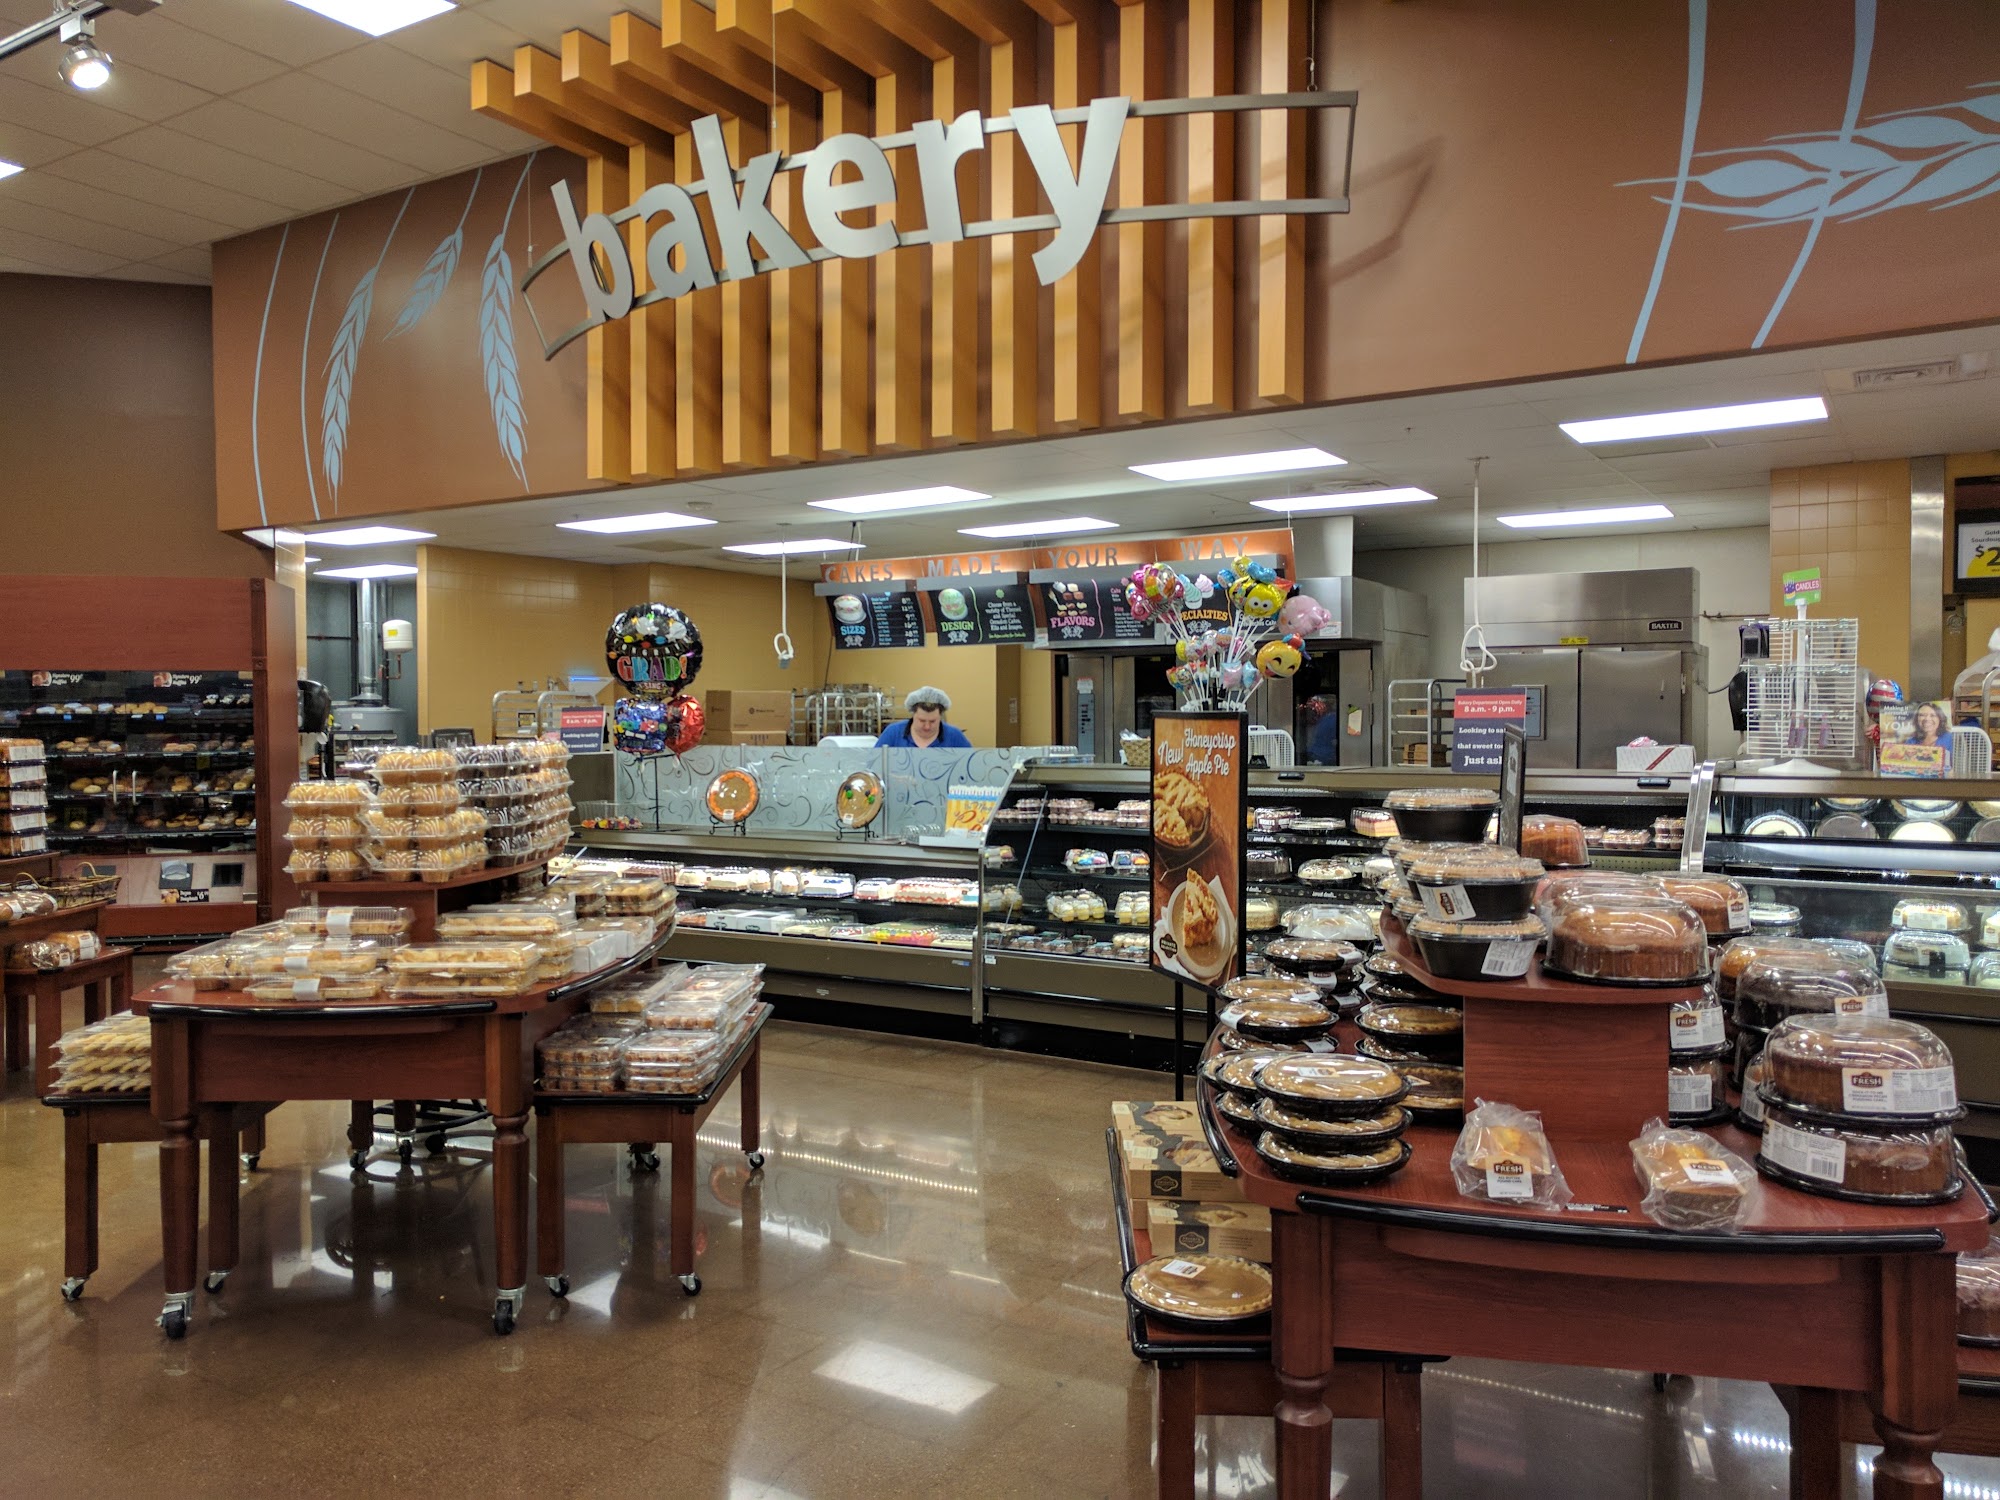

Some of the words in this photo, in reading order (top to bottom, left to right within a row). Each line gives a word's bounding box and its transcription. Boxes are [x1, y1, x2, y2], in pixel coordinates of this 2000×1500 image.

[550, 96, 1131, 323] bakery
[825, 563, 893, 583] CAKES
[927, 554, 1001, 577] MADE
[1048, 547, 1118, 569] YOUR
[1180, 537, 1248, 560] WAY
[1795, 580, 1819, 591] CANDLES
[1181, 609, 1228, 621] PECIALTIES
[941, 621, 974, 632] DESIGN
[1050, 616, 1095, 629] FLAVORS
[840, 625, 866, 636] SIZES
[617, 655, 688, 681] GRAD!
[1184, 728, 1236, 757] Honeycrisp
[1158, 738, 1184, 766] New!
[1186, 752, 1212, 780] Apple
[1213, 754, 1229, 775] Pie
[1464, 756, 1484, 766] Just
[1853, 1077, 1882, 1085] FRESH
[1495, 1164, 1522, 1173] FRESH
